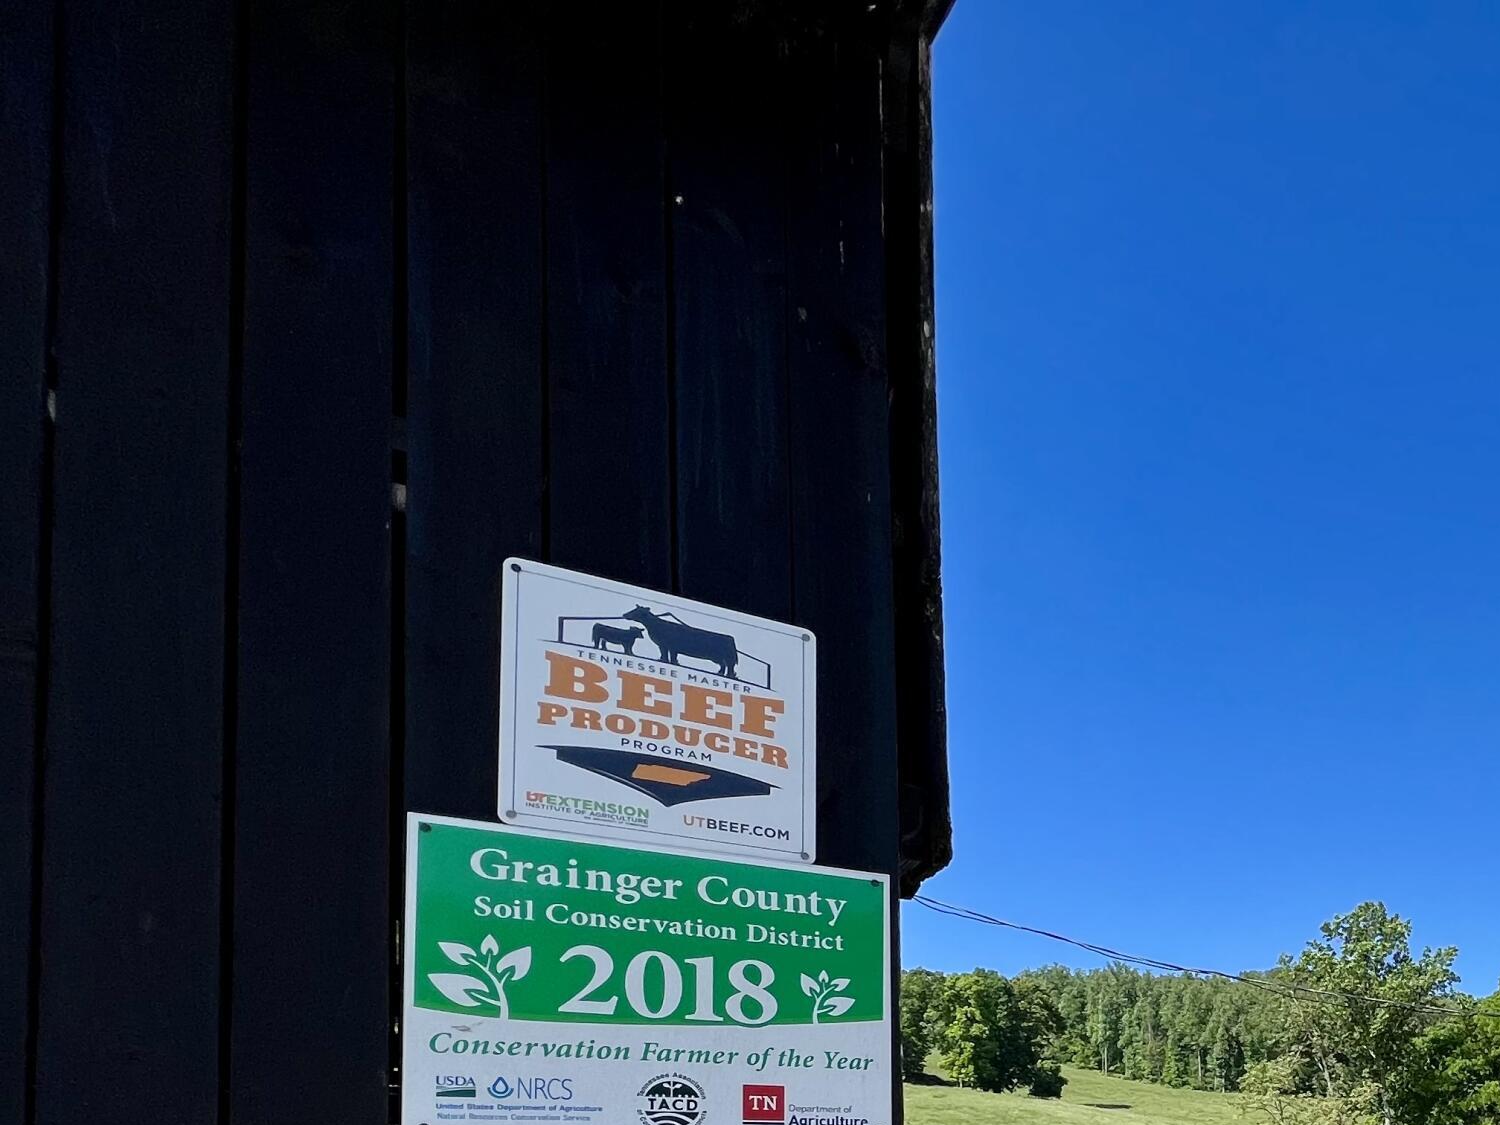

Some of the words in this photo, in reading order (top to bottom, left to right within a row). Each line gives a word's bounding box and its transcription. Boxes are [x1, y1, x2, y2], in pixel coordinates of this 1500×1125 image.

[577, 650, 679, 678] TENNESSEE
[687, 673, 751, 694] MASTER
[544, 650, 785, 739] BEEF
[537, 701, 789, 769] PRODUCER
[621, 737, 712, 762] PROGRAM
[526, 802, 571, 814] INSTITUTE
[590, 811, 649, 825] AGRICULTURE
[683, 814, 790, 841] UTBEEF.COM
[469, 847, 683, 904] Grainger
[697, 876, 847, 925] County
[473, 896, 533, 921] Soil
[546, 903, 736, 941] Conservation
[748, 924, 844, 951] District
[557, 944, 779, 1027] 2018
[429, 1032, 630, 1061] Conservation
[640, 1042, 739, 1065] Farmer
[746, 1047, 773, 1072] of
[778, 1047, 813, 1068] the
[824, 1050, 874, 1072] Year
[436, 1075, 476, 1086] USDA
[517, 1077, 573, 1100] NRCS
[648, 1098, 698, 1111] TACD
[749, 1095, 777, 1111] TN
[788, 1104, 841, 1114] Department
[843, 1105, 852, 1113] of
